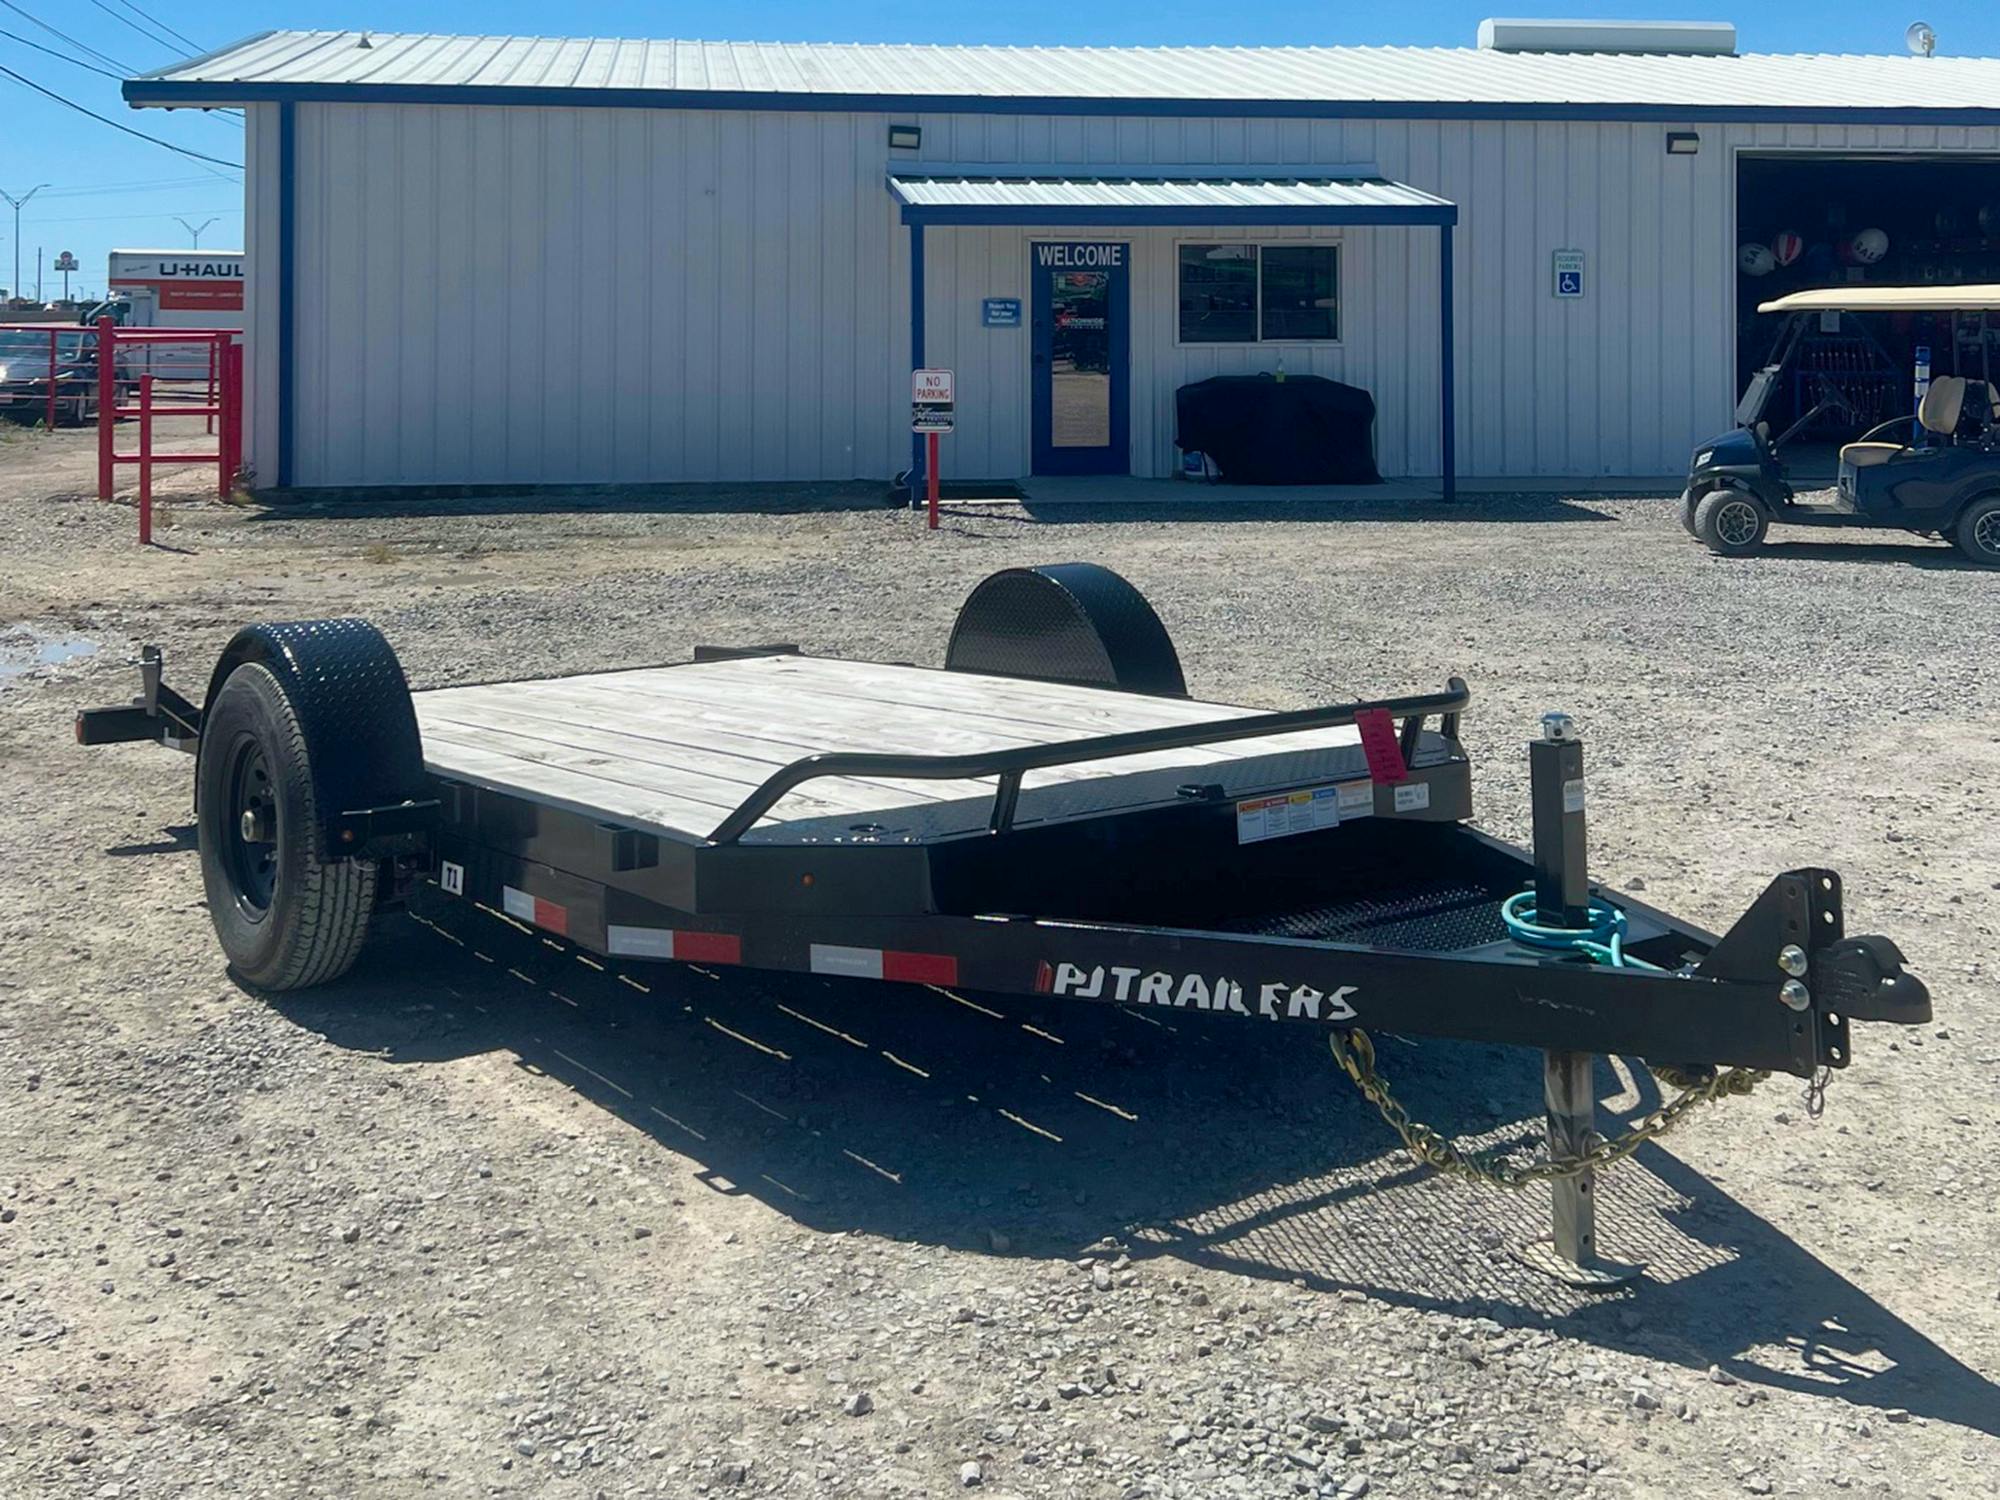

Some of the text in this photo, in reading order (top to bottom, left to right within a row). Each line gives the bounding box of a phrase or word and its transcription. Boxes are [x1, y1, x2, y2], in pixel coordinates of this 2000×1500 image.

[1038, 245, 1121, 266] WELCOME
[926, 376, 941, 387] NO
[916, 388, 950, 400] PARKING
[1110, 965, 1360, 1022] TRAILERS
